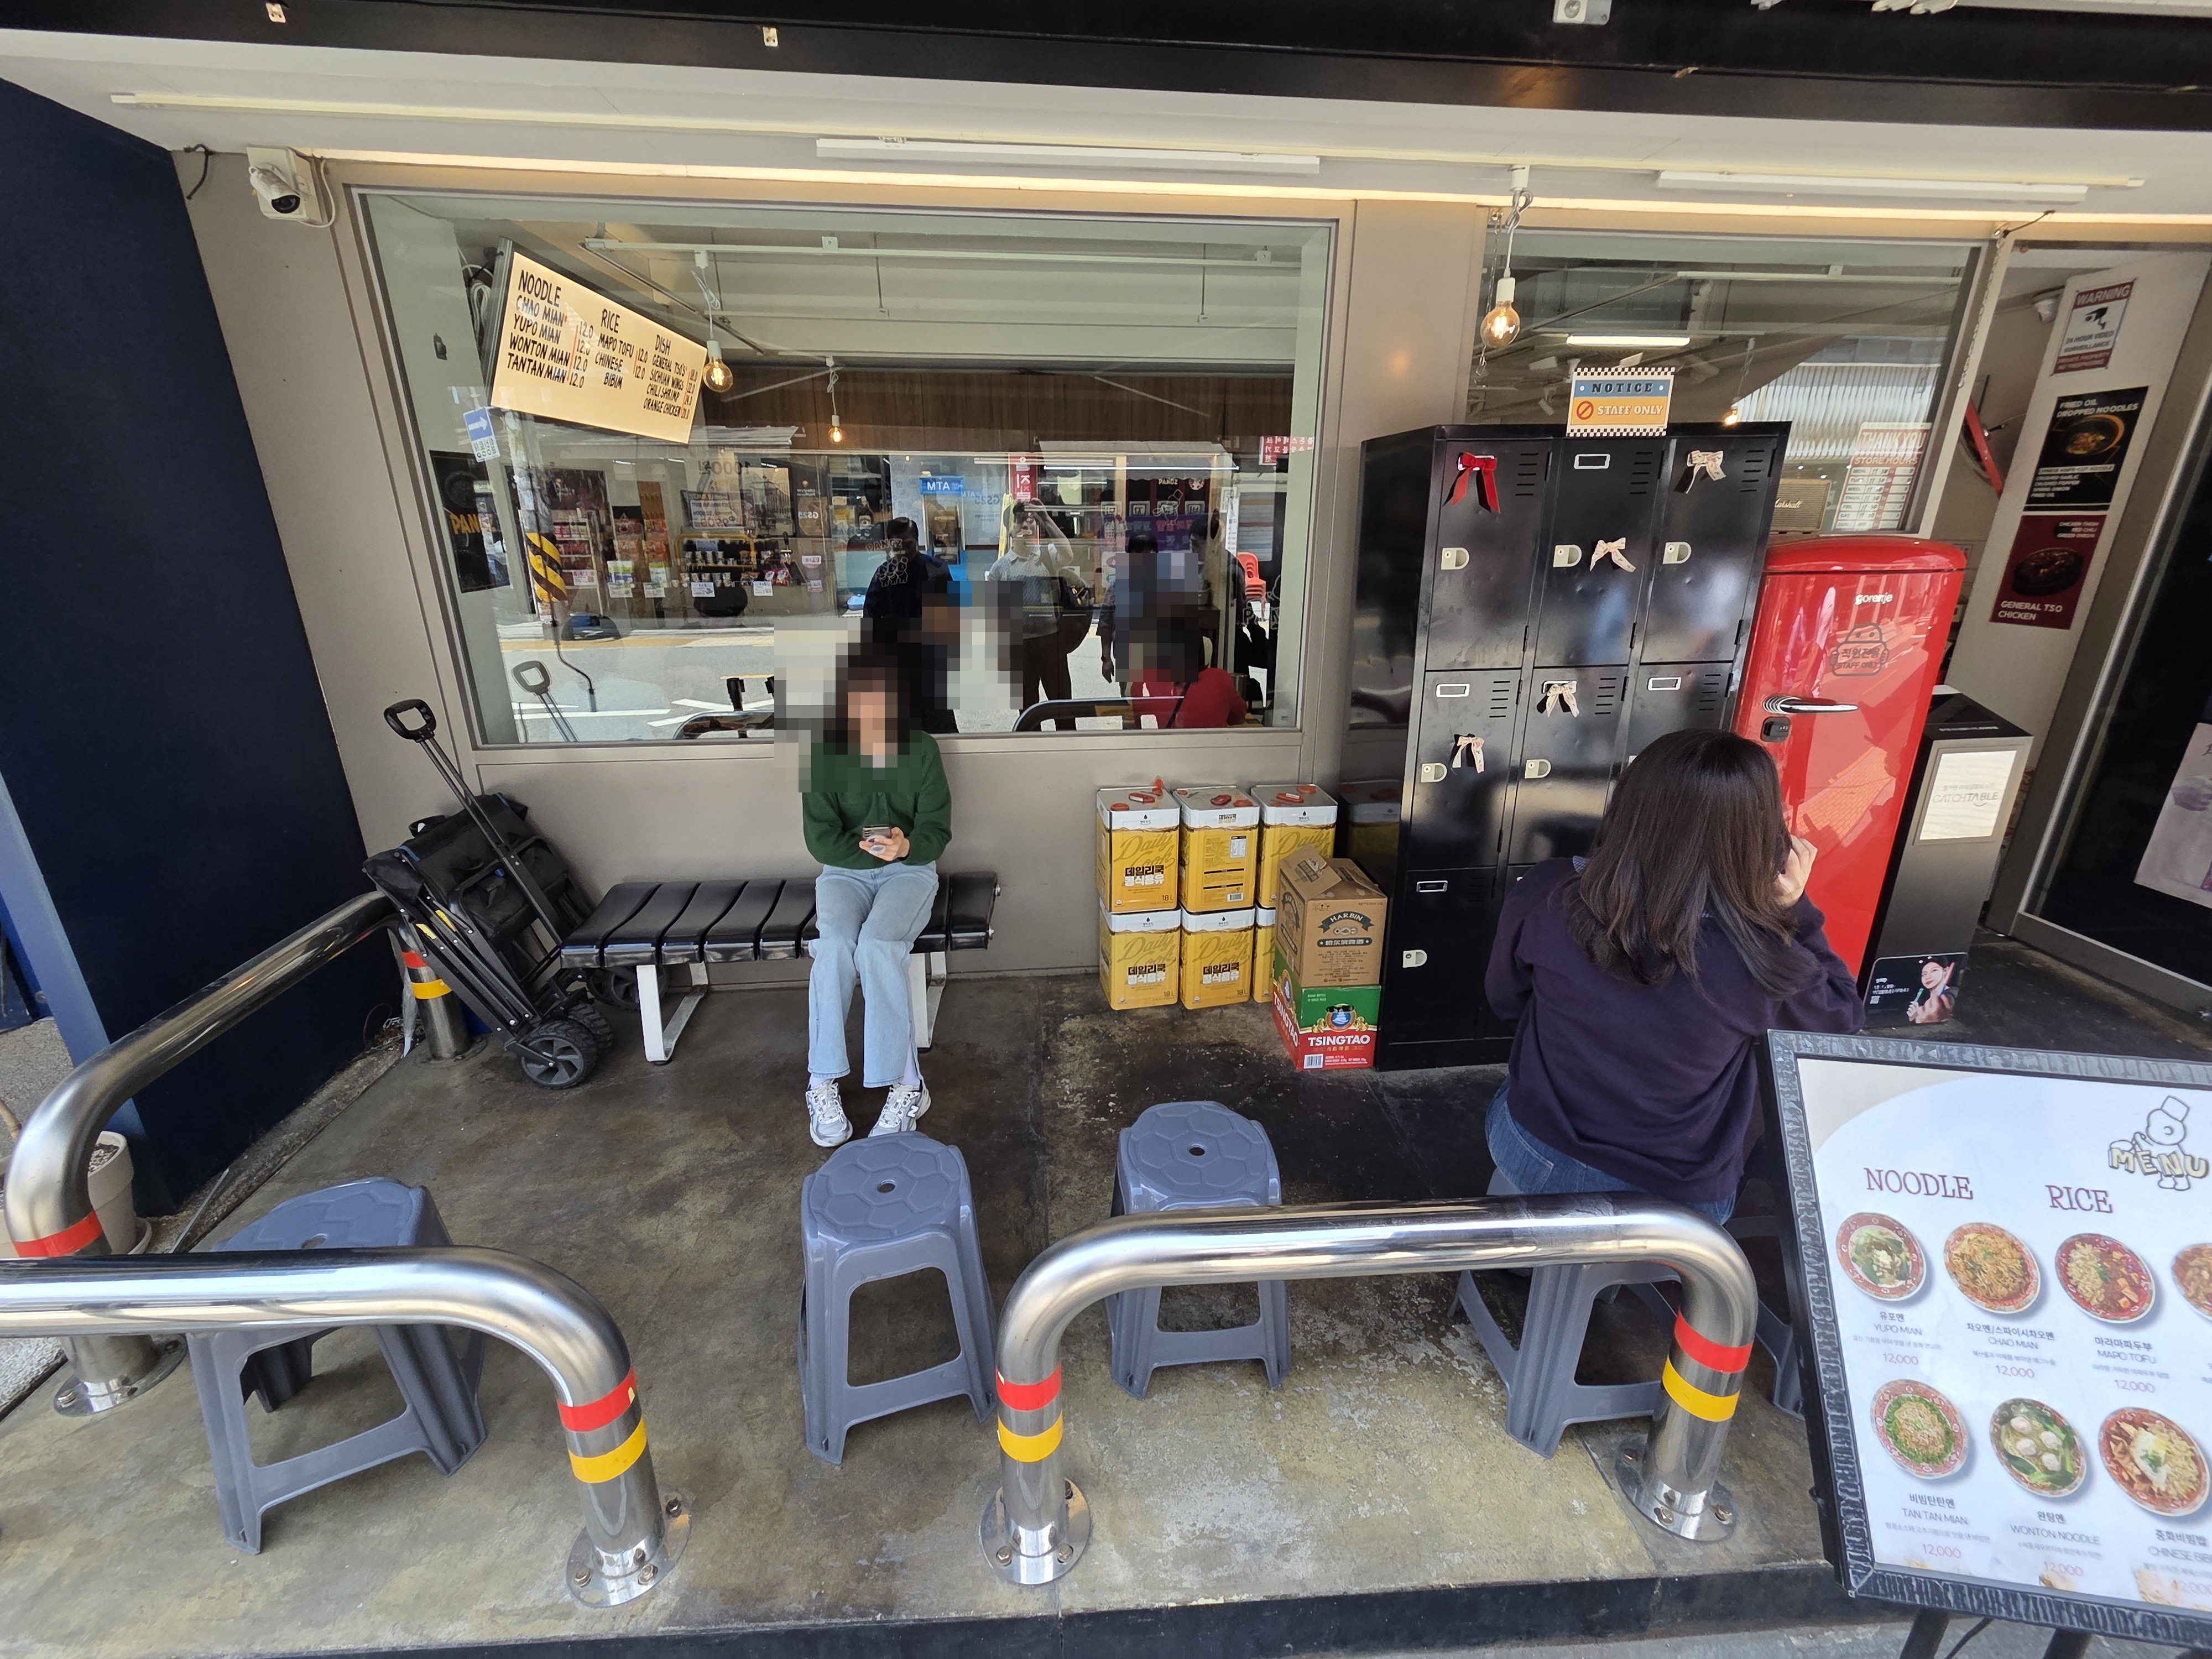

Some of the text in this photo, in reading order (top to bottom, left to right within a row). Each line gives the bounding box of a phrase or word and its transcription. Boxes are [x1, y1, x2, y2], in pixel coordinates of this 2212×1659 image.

[518, 269, 561, 307] NOODLE
[2077, 285, 2130, 305] WARNING
[516, 295, 593, 339] CHAO MIAN 12.0
[601, 308, 620, 333] RICE
[514, 314, 538, 336] YUPO
[539, 324, 561, 345] MIAN
[509, 332, 588, 372] WONTON MIAN 12.0
[597, 333, 648, 363] MAPO TOFU 12.0
[655, 334, 671, 356] DISH
[507, 352, 585, 388] TANTAN MIAN 12.0
[595, 352, 645, 380] CHINESE 12.0
[603, 372, 623, 390] BIBIM
[1592, 383, 1653, 393] NOTICE
[1597, 405, 1663, 415] STAFF ONLY
[1861, 432, 1927, 450] THANK YOU
[1885, 457, 1918, 465] HOURS
[1855, 592, 1893, 606] gorenje
[2001, 601, 2063, 613] GENERAL TSO
[1998, 611, 2037, 620] CHICKEN
[1841, 648, 1880, 659] 직원전용
[1933, 792, 1999, 804] CATCHTABLE
[1113, 833, 1173, 863] Daily
[1270, 830, 1330, 858] Daily
[1130, 844, 1175, 869] Cook
[1125, 864, 1164, 877] 데일리쿡
[1330, 912, 1364, 922] HARBIN
[1117, 934, 1174, 962] Daily
[1192, 933, 1249, 962] Daily
[1128, 963, 1166, 975] 데일리쿡
[1203, 962, 1240, 975] 데일리쿡
[1274, 992, 1298, 1047] TSINGTAO
[1308, 1035, 1370, 1046] TSINGTAO
[2108, 1146, 2211, 1181] MENU
[1864, 1167, 1974, 1200] NOODLE
[2046, 1185, 2114, 1214] RICE
[1874, 1323, 1923, 1335] YUPO MIAN
[1988, 1337, 2039, 1349] CHAO MIAN
[2094, 1337, 2153, 1352] 마라마파두부
[2097, 1349, 2157, 1364] MAPO TOFU
[1902, 1507, 1969, 1525] TAN TAN MIAN
[2010, 1525, 2101, 1545] WONTON NOODLE
